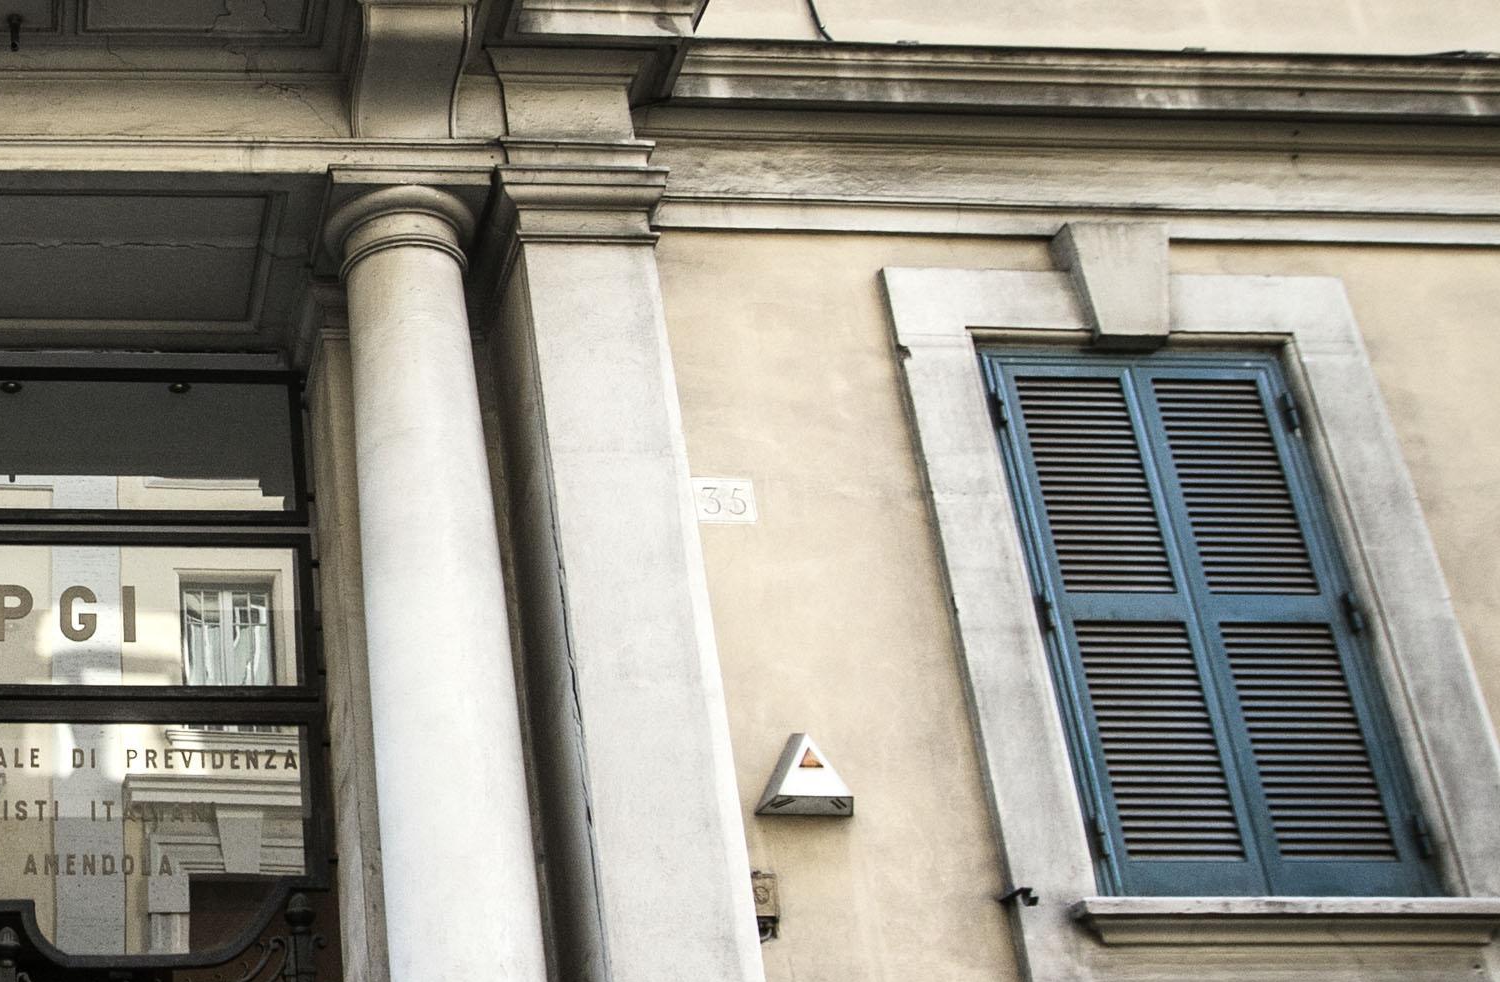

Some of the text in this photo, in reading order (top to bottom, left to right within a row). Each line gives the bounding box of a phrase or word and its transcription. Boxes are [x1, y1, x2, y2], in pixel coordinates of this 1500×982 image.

[702, 486, 747, 515] 35
[71, 748, 96, 769] DI
[125, 748, 299, 770] PREVIDENZA
[23, 853, 173, 877] AMENDOLA
